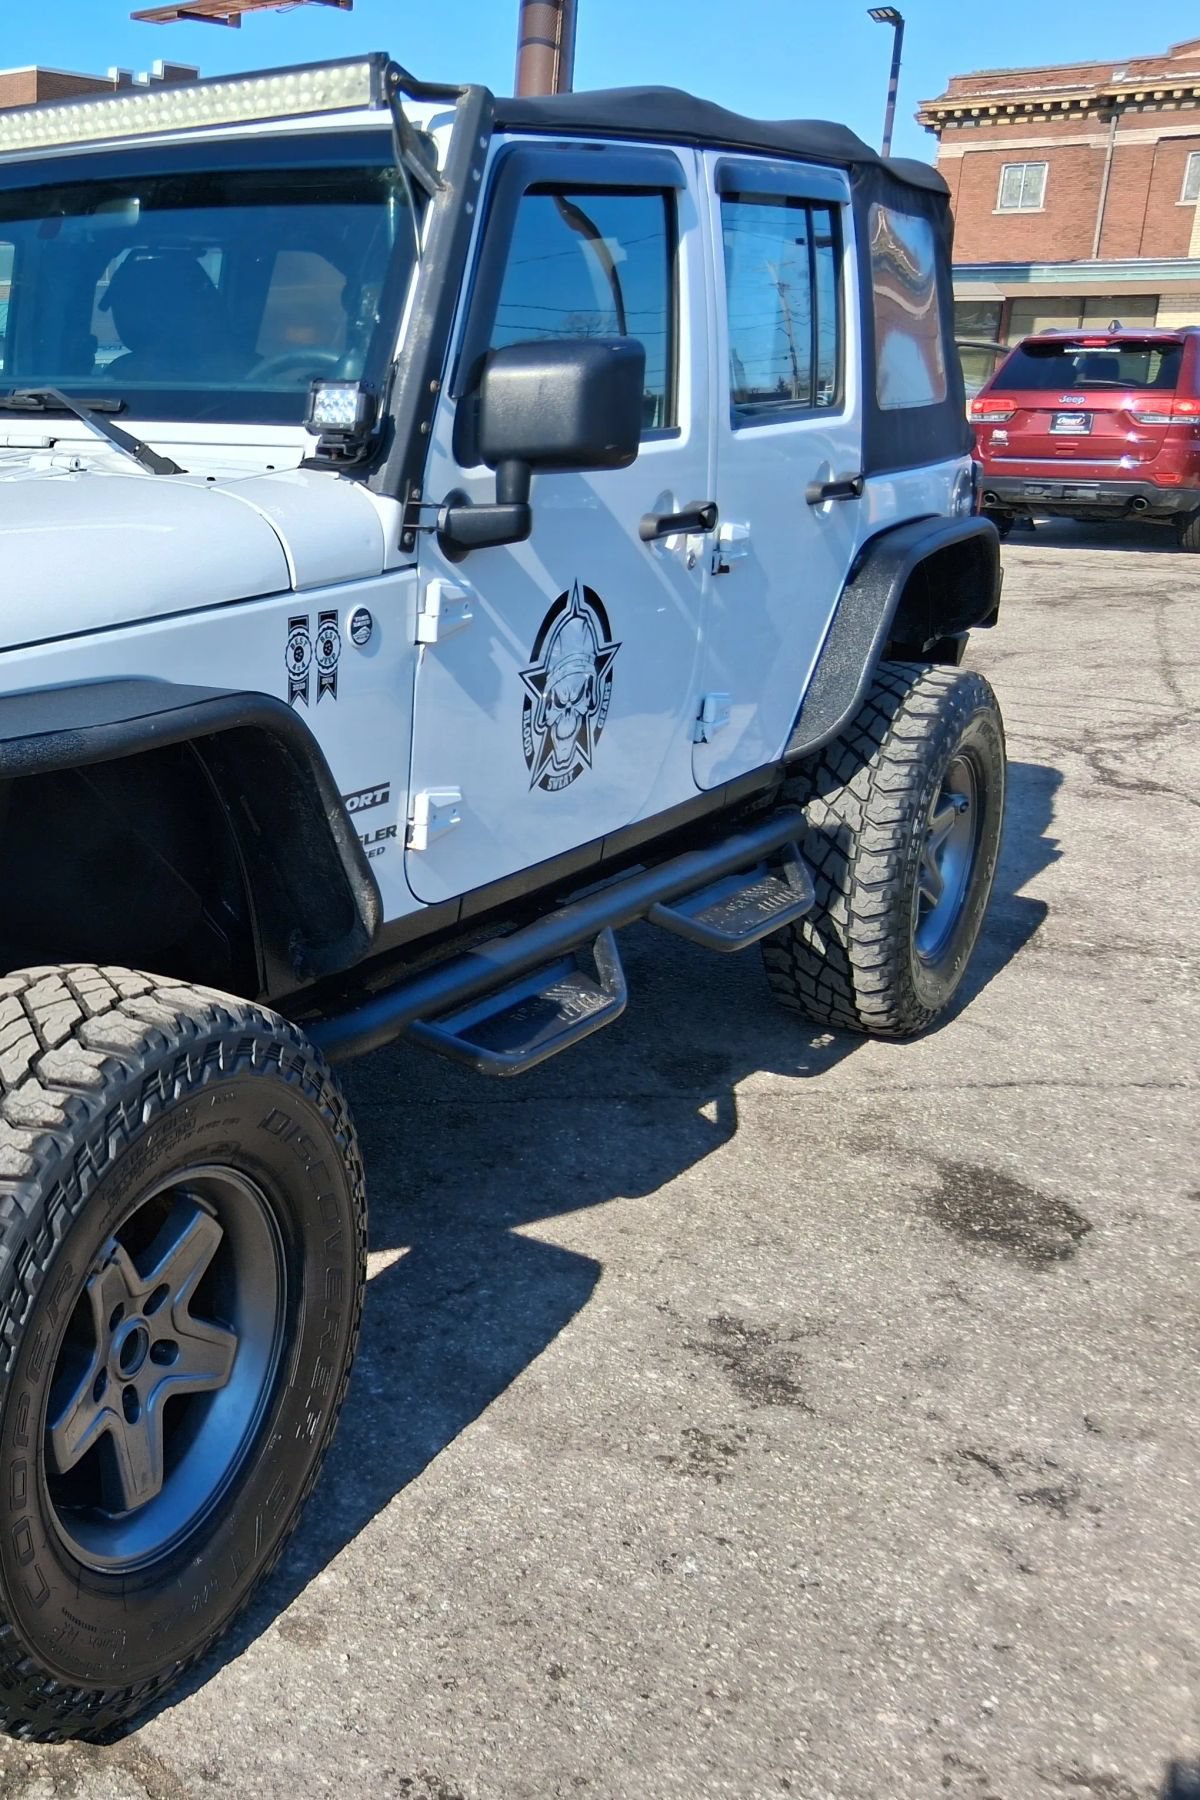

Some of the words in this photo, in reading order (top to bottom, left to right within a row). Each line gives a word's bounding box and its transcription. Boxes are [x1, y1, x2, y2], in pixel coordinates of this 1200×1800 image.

[1059, 395, 1085, 405] Jeep
[290, 637, 308, 651] BEST
[320, 631, 337, 643] BEST
[523, 709, 533, 757] BLOOD
[546, 769, 575, 790] SWEAT
[345, 788, 389, 811] ORT
[9, 1260, 78, 1611] COOPER
